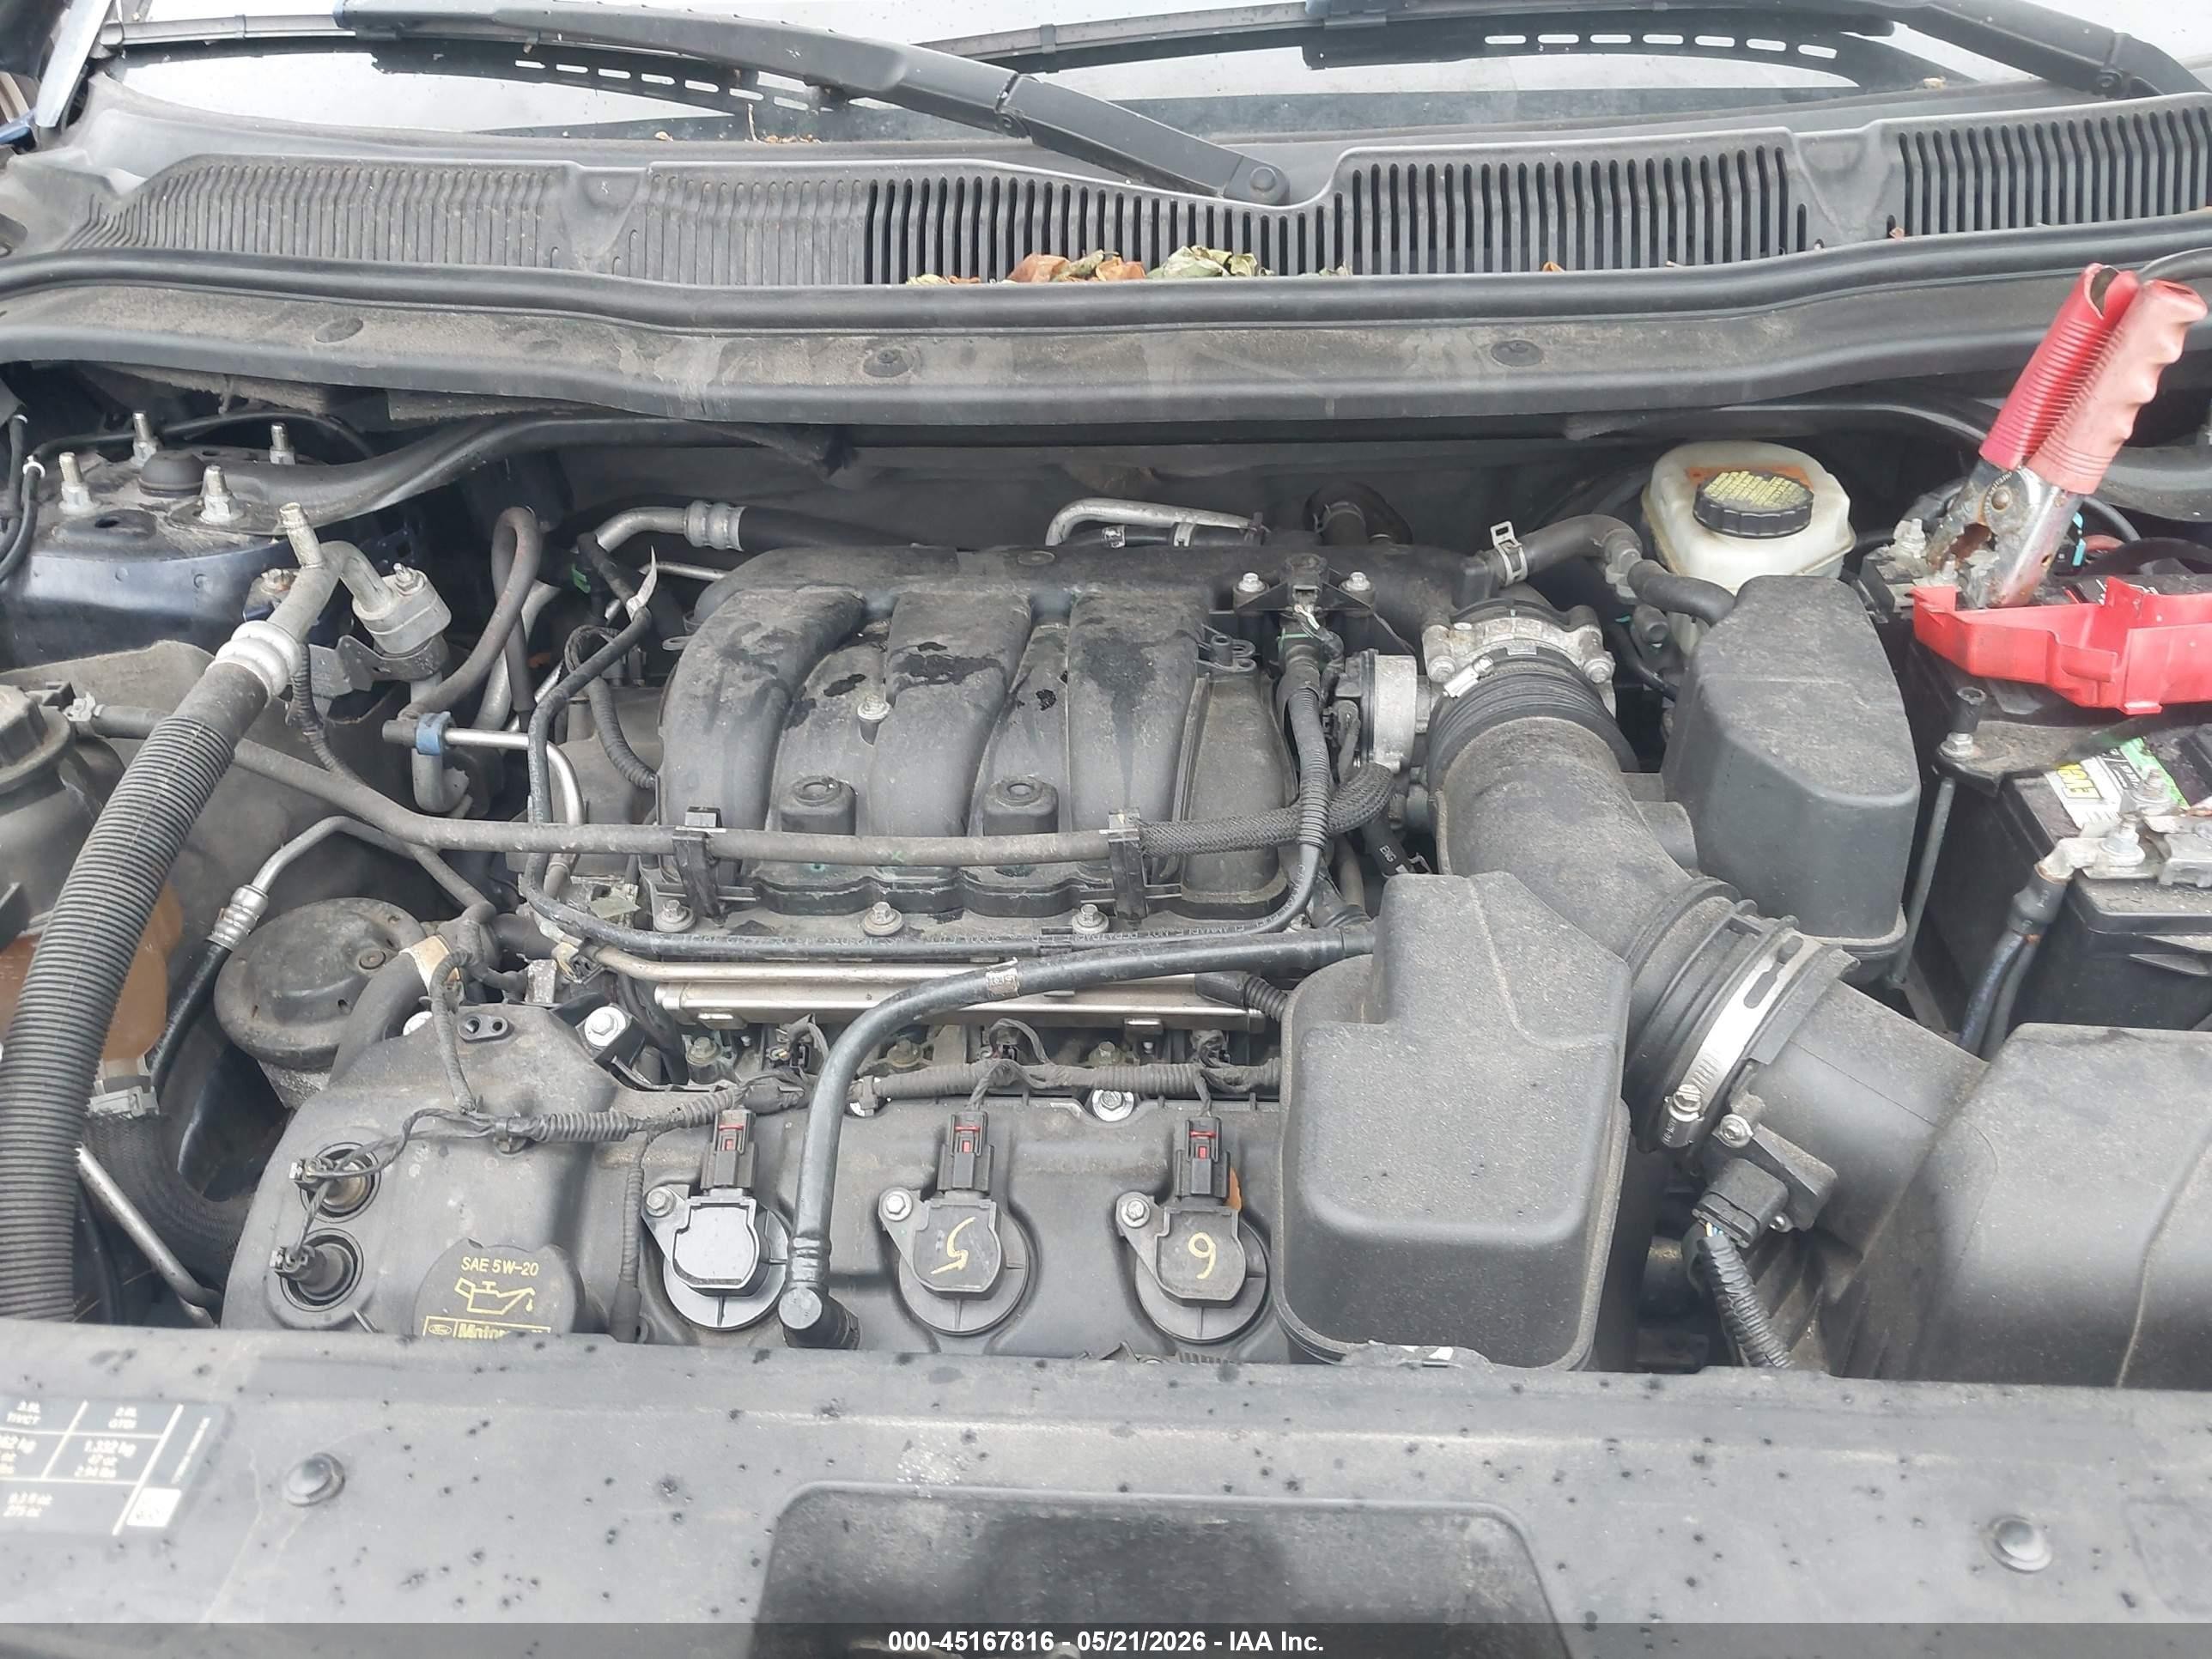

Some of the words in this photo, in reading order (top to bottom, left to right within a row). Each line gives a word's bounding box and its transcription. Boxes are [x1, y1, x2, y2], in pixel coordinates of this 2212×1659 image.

[1379, 844, 1397, 862] ENG
[461, 1256, 489, 1273] SAE
[491, 1259, 539, 1277] 5W-20
